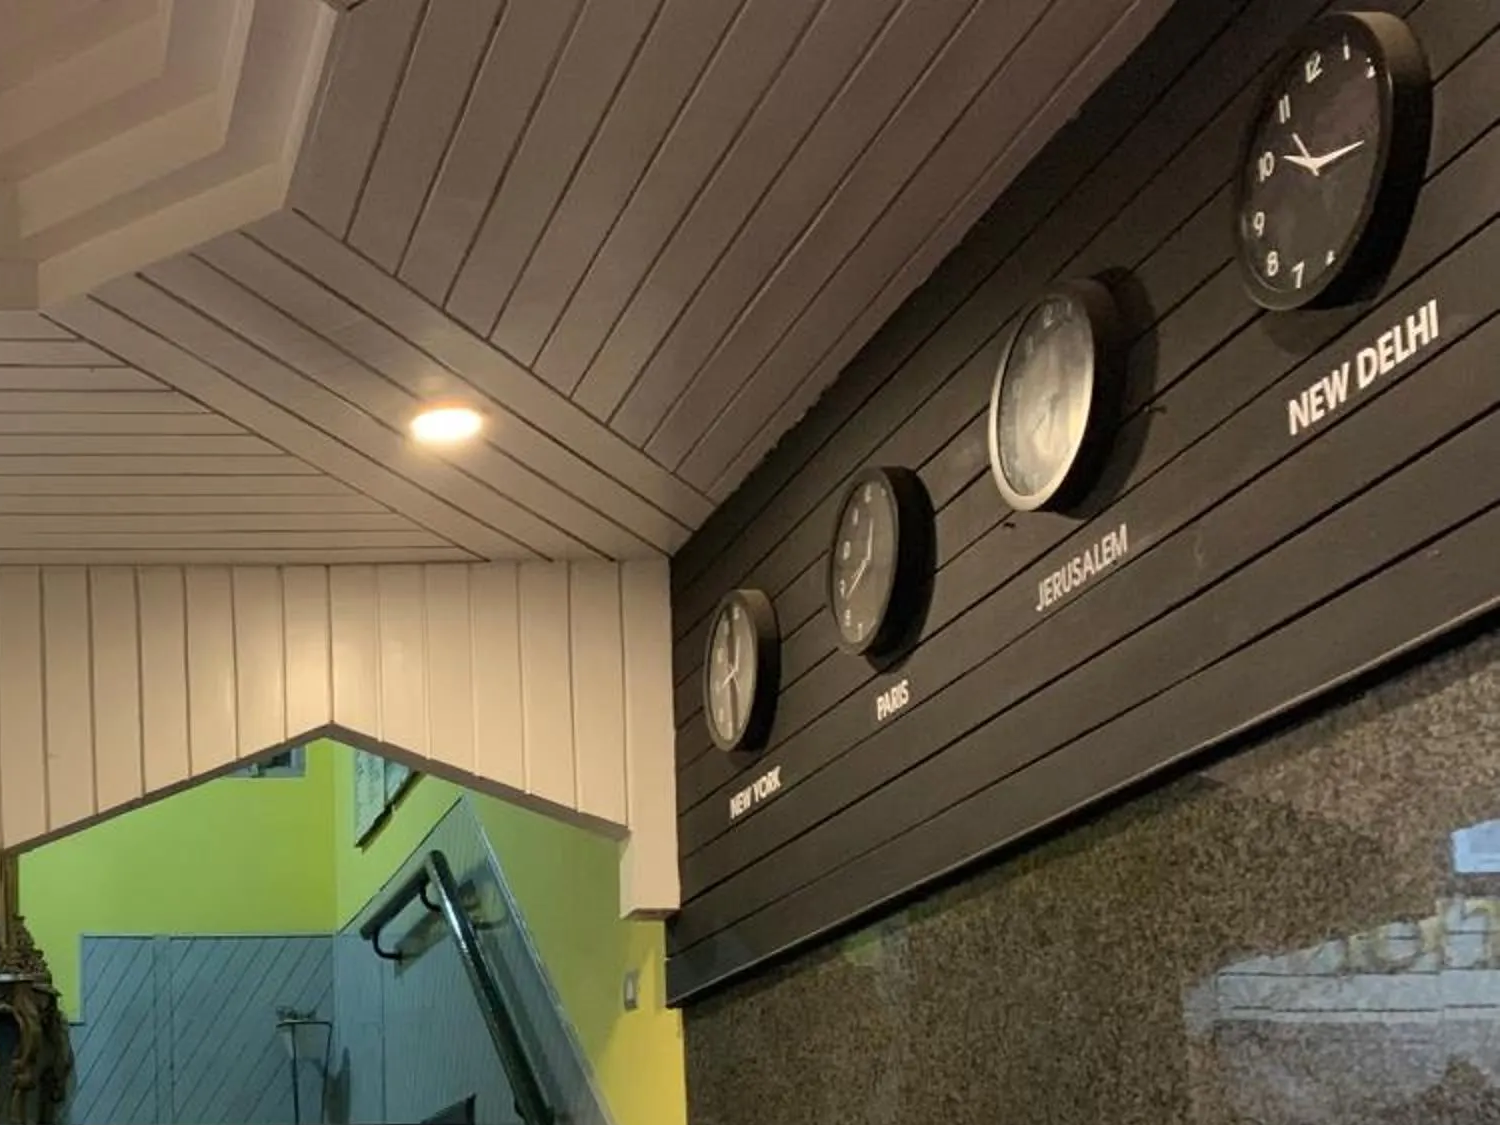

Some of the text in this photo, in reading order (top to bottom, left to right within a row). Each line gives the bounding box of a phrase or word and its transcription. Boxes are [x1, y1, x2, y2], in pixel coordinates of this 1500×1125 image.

[1278, 95, 1291, 124] 11
[1258, 152, 1275, 182] 10
[1253, 212, 1265, 236] 9
[1266, 251, 1279, 277] 8
[1292, 262, 1304, 289] 7
[1288, 300, 1439, 435] NEW DELHI
[1036, 524, 1128, 611] JERUSALEM
[876, 680, 909, 721] PARIS
[730, 766, 781, 819] NEW YORK
